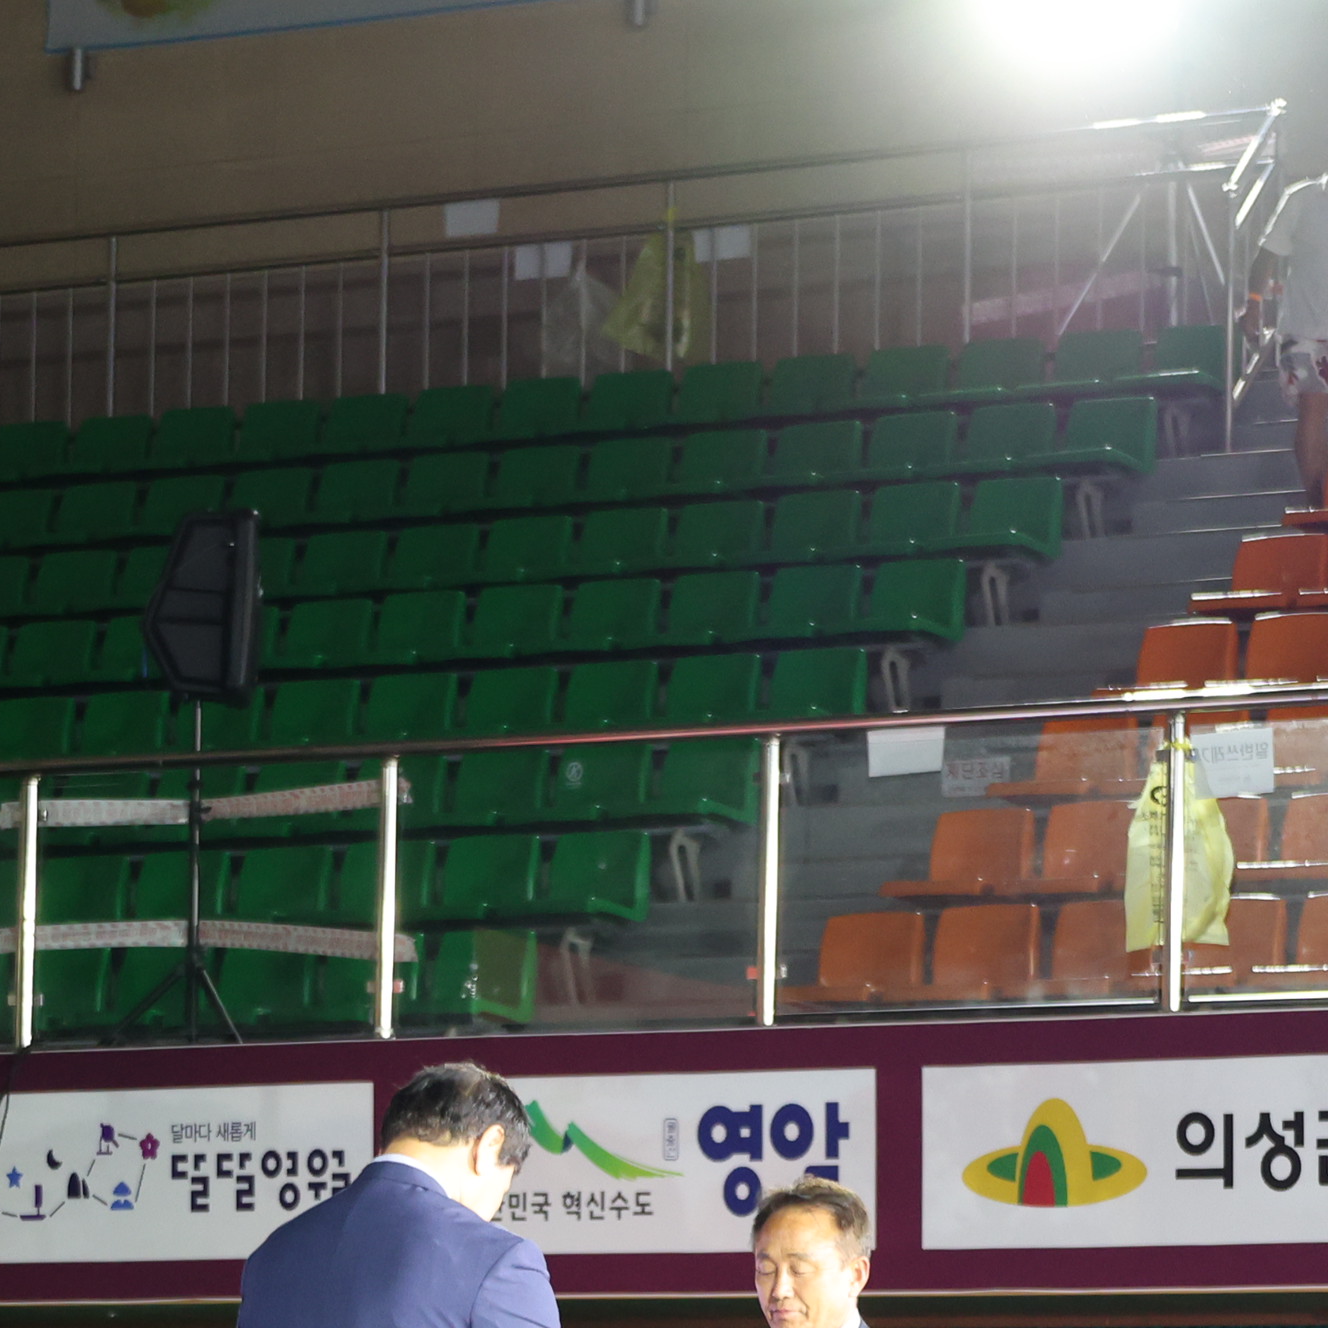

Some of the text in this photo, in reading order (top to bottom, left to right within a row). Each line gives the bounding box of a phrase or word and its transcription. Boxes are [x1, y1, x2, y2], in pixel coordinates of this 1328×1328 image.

[171, 1121, 257, 1143] 달마다 새롭게
[561, 1191, 653, 1221] 혁신수도
